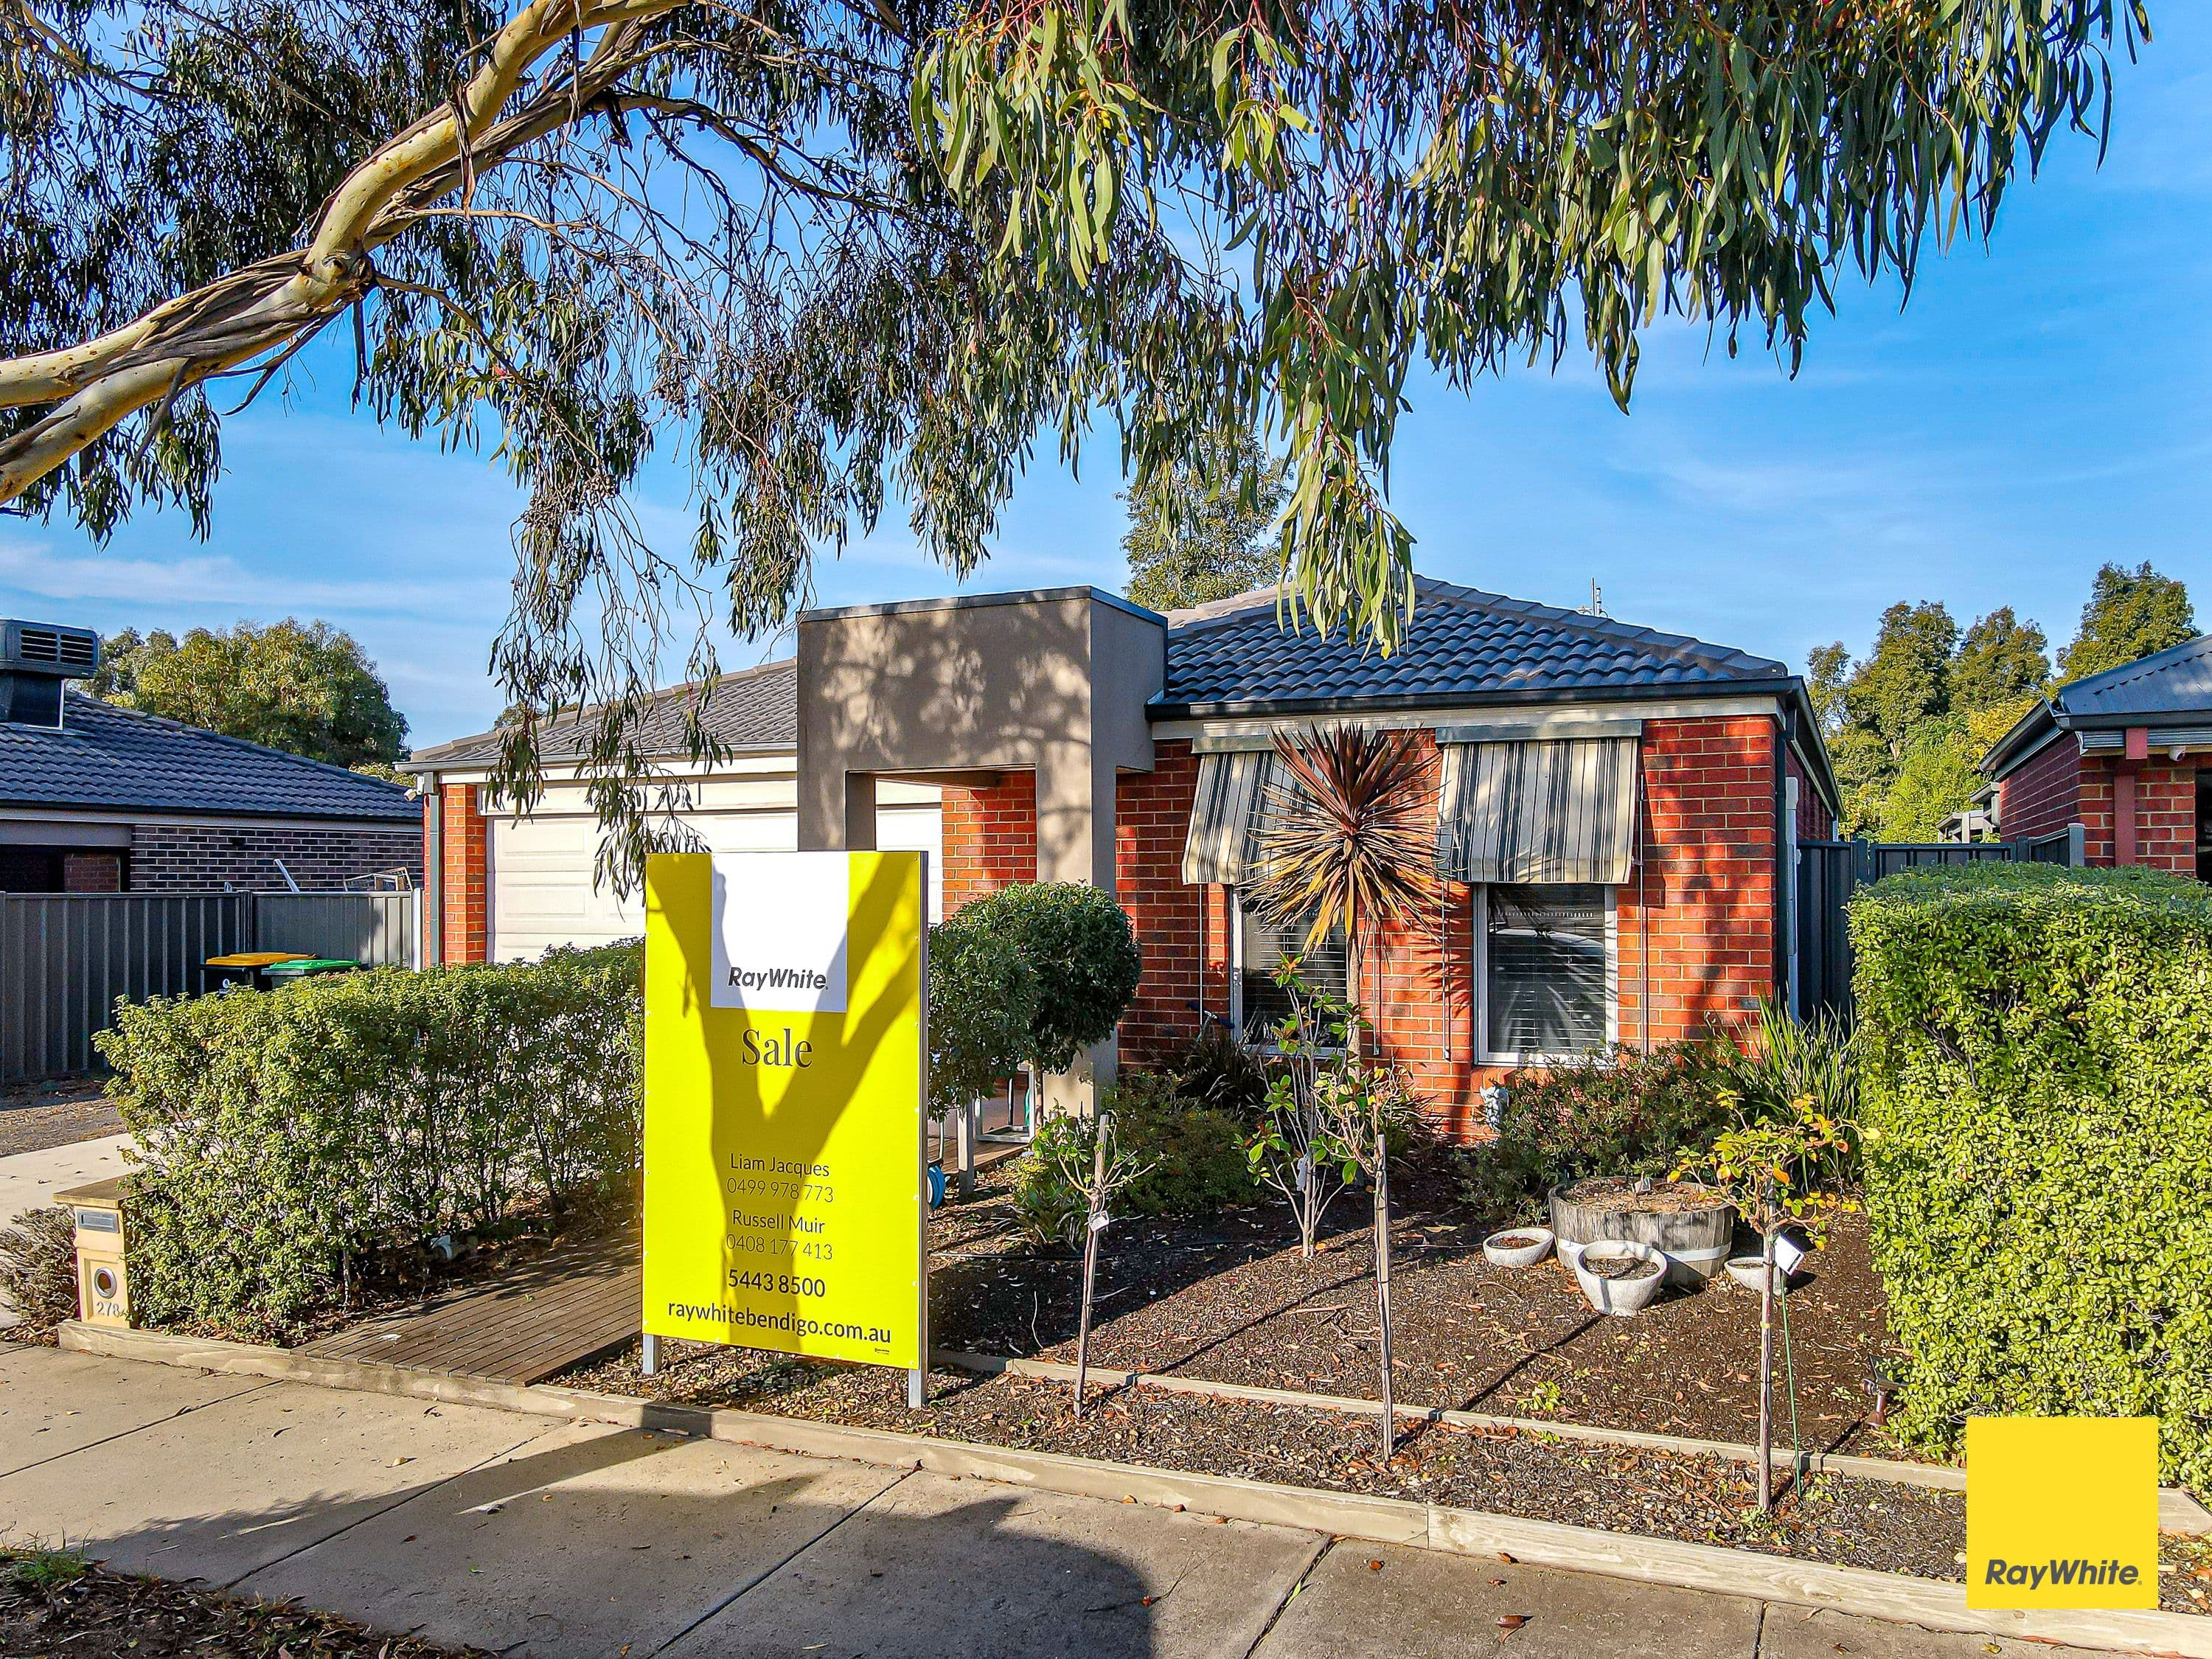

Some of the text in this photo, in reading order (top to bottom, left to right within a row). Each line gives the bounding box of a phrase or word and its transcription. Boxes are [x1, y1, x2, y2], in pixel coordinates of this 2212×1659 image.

[742, 1028, 813, 1068] Sale
[731, 1152, 830, 1178] Liam Jacques
[726, 1178, 834, 1203] 0499 978 773
[732, 1210, 825, 1234] Russell Muir
[726, 1234, 833, 1261] 0408 177 413
[728, 1269, 826, 1298] 5443 8500
[668, 1301, 891, 1343] raywhitebendigo.com.au
